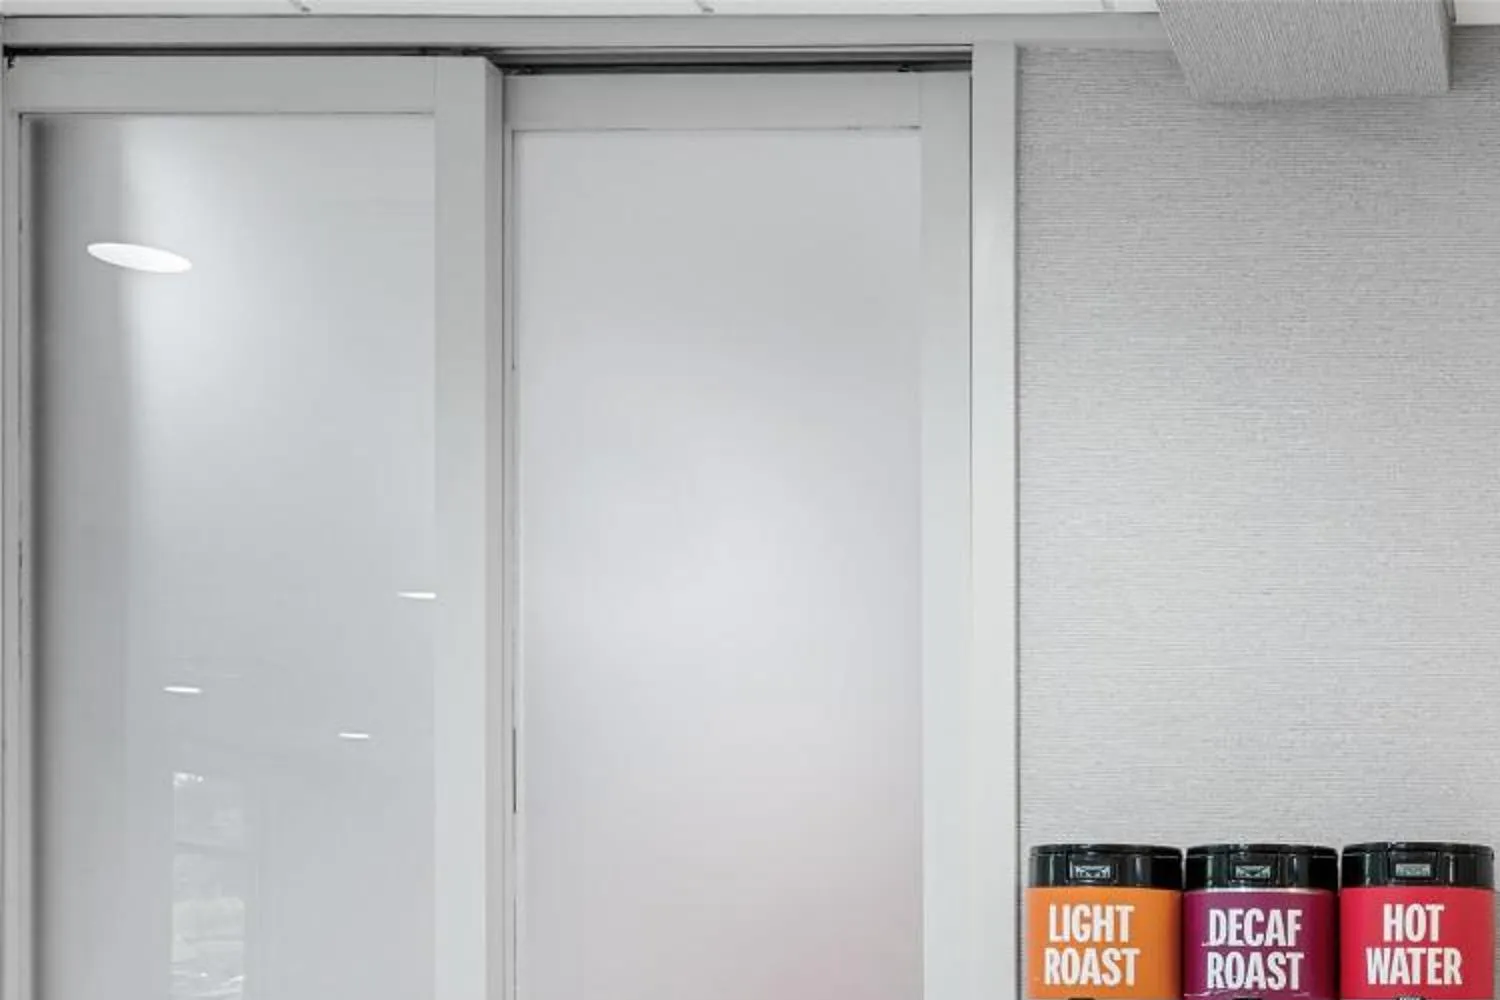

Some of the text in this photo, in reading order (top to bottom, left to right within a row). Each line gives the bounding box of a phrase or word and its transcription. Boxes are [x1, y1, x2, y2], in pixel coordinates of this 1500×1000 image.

[1048, 903, 1136, 942] LIGHT
[1208, 908, 1303, 947] DECAF
[1383, 903, 1445, 942] HOT
[1043, 947, 1141, 987] ROAST
[1206, 951, 1305, 990] ROAST
[1365, 947, 1463, 985] WATER
